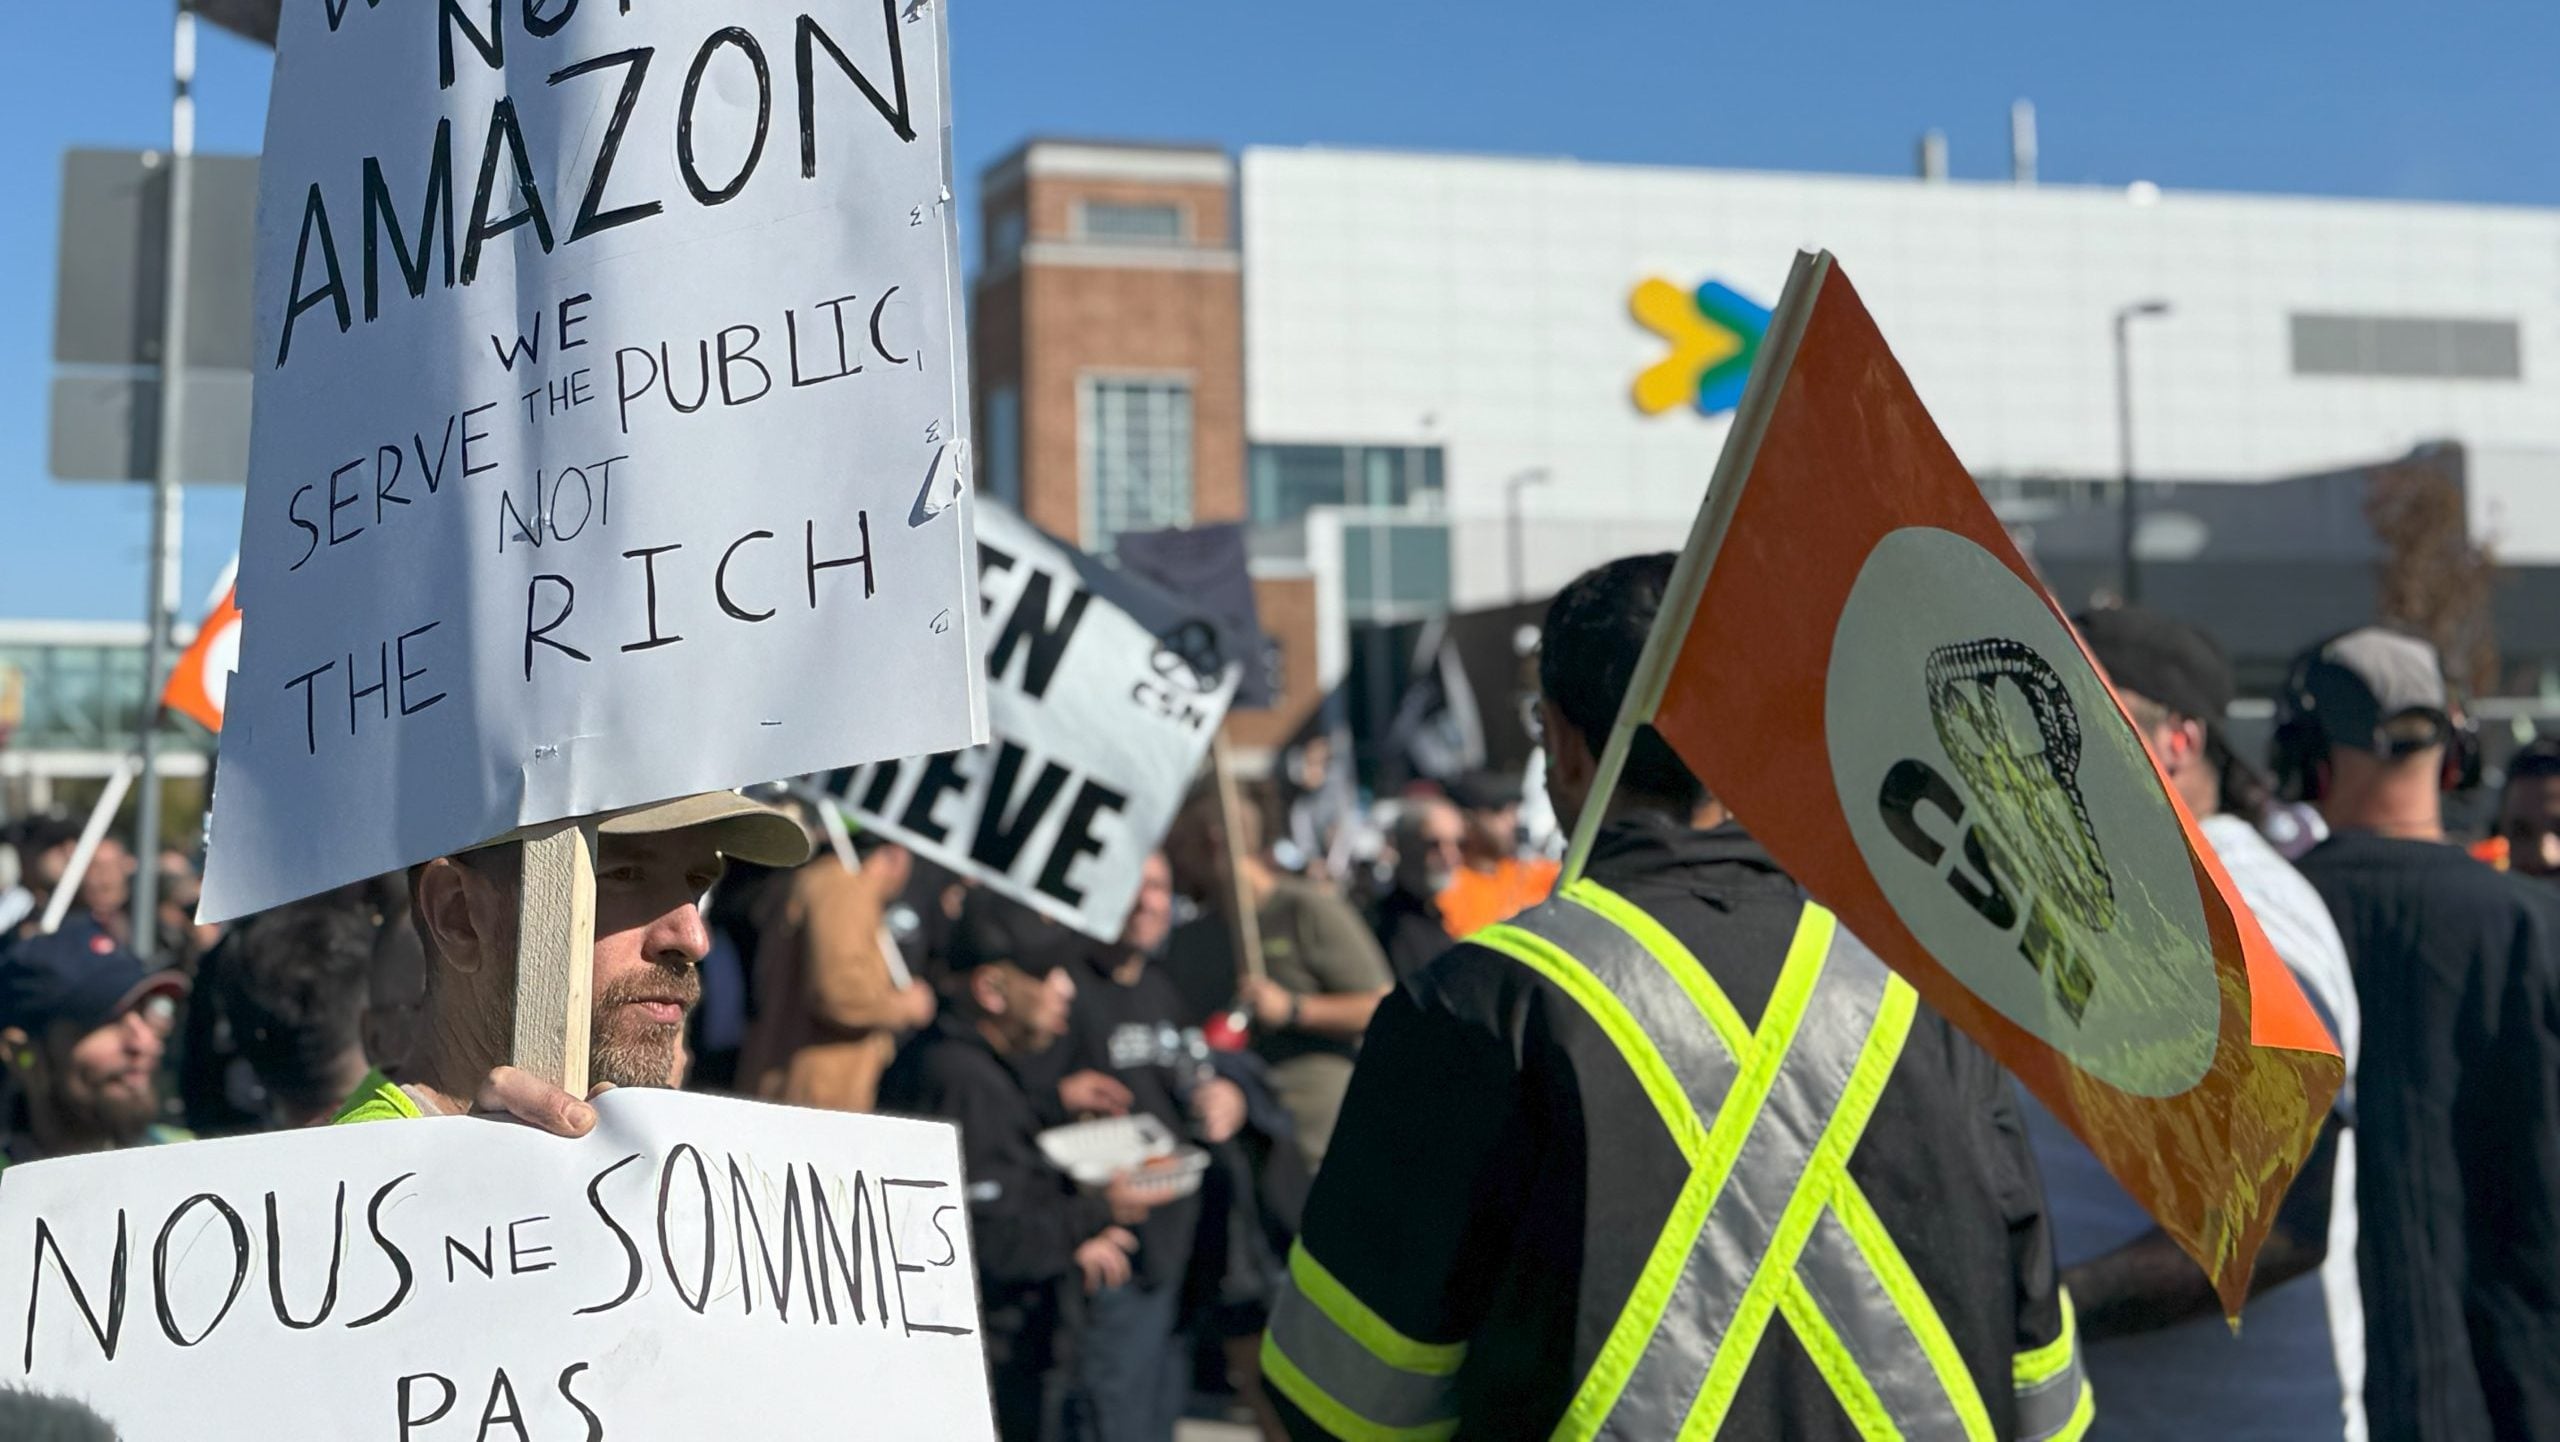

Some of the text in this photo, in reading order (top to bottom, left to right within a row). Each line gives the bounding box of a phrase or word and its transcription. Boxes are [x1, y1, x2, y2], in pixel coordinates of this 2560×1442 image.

[275, 0, 917, 370] AMAZON
[491, 293, 592, 371] WE
[289, 403, 499, 571] SERVE
[522, 368, 595, 424] THE
[499, 456, 629, 554] NOT
[285, 510, 874, 754] THE RICH
[1878, 758, 2098, 1029] CSN
[24, 1143, 974, 1374] NOUS NE SOMMES
[397, 1362, 603, 1442] PAS
